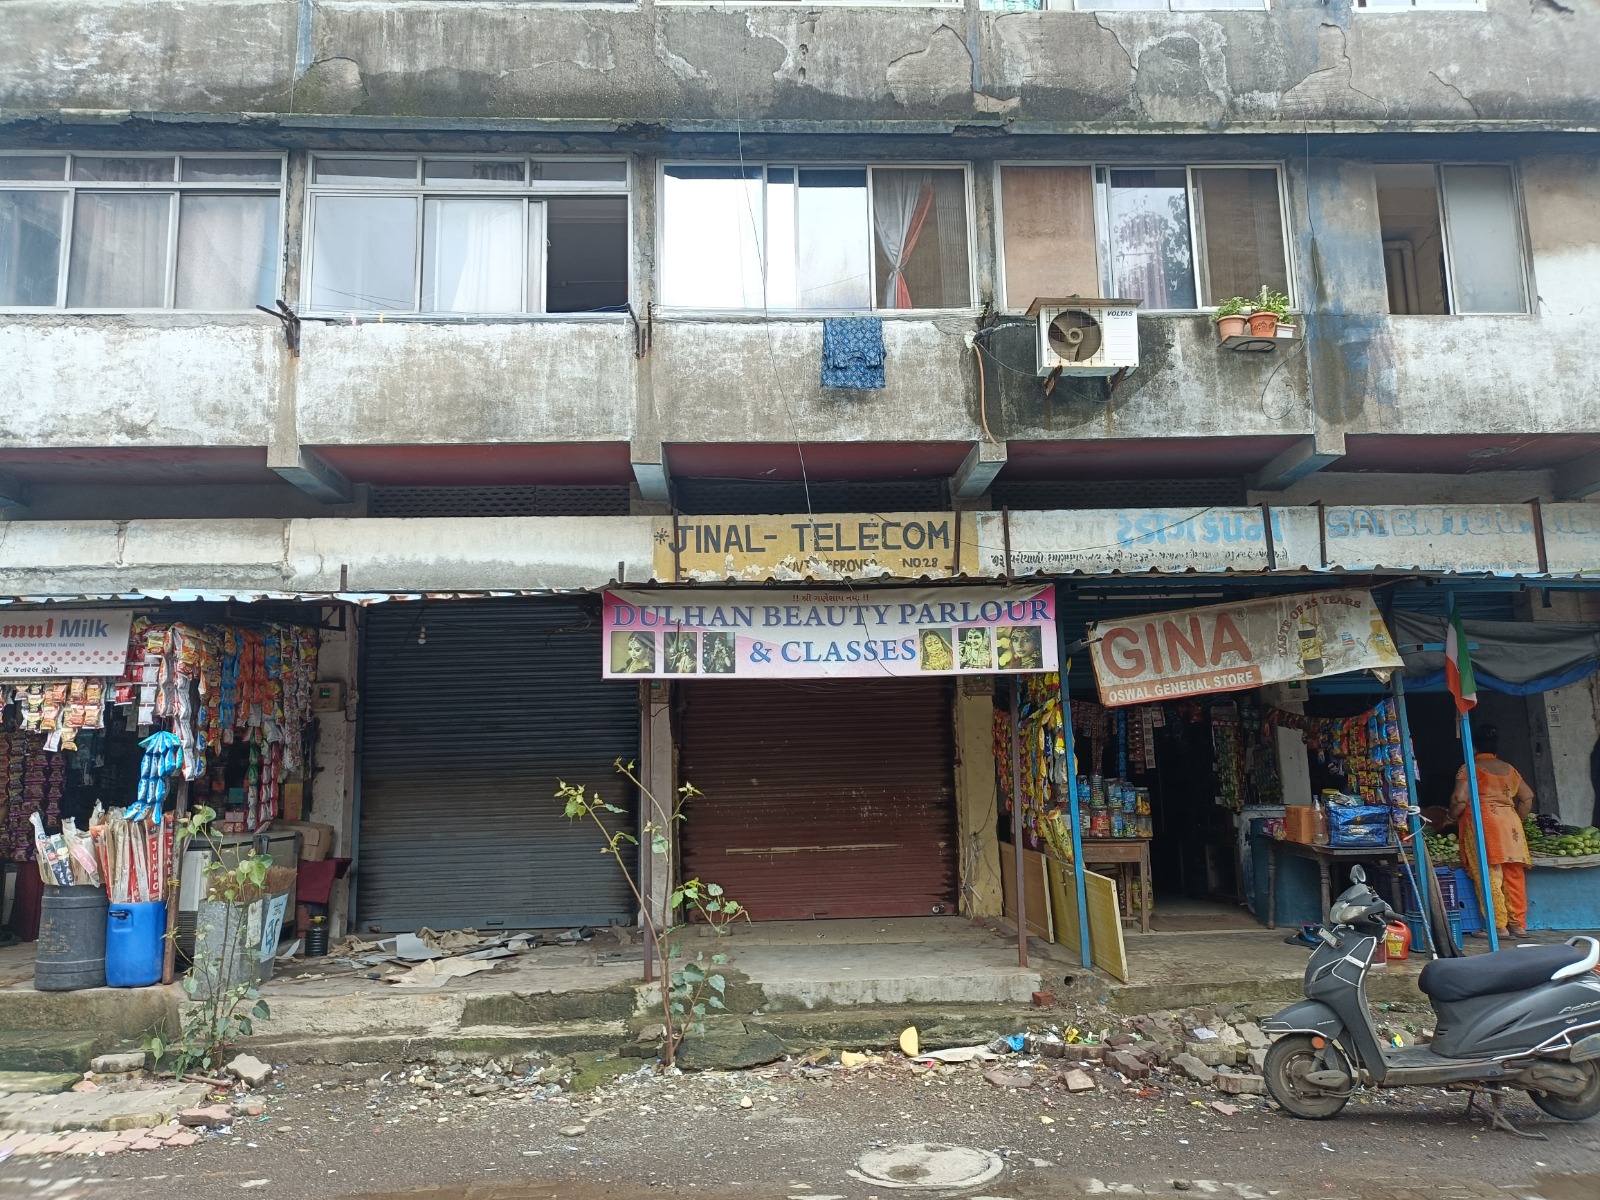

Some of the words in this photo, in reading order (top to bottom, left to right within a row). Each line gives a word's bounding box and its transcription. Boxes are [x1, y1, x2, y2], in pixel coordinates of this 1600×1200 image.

[790, 520, 950, 552] TELECOM
[0, 617, 54, 639] mul
[59, 618, 110, 638] Milk
[612, 604, 754, 627] DULHAN
[762, 603, 894, 627] BEAUTY
[898, 598, 1052, 626] PARLOUR
[1277, 619, 1293, 658] TASTE
[1289, 604, 1304, 621] OF
[1320, 594, 1362, 609] YEARS
[750, 641, 772, 664] &
[781, 639, 917, 663] CLASSES
[1101, 612, 1253, 679] GINA
[1108, 686, 1152, 703] OSWAL
[1154, 679, 1212, 697] GENERAL
[1214, 671, 1254, 688] STORE
